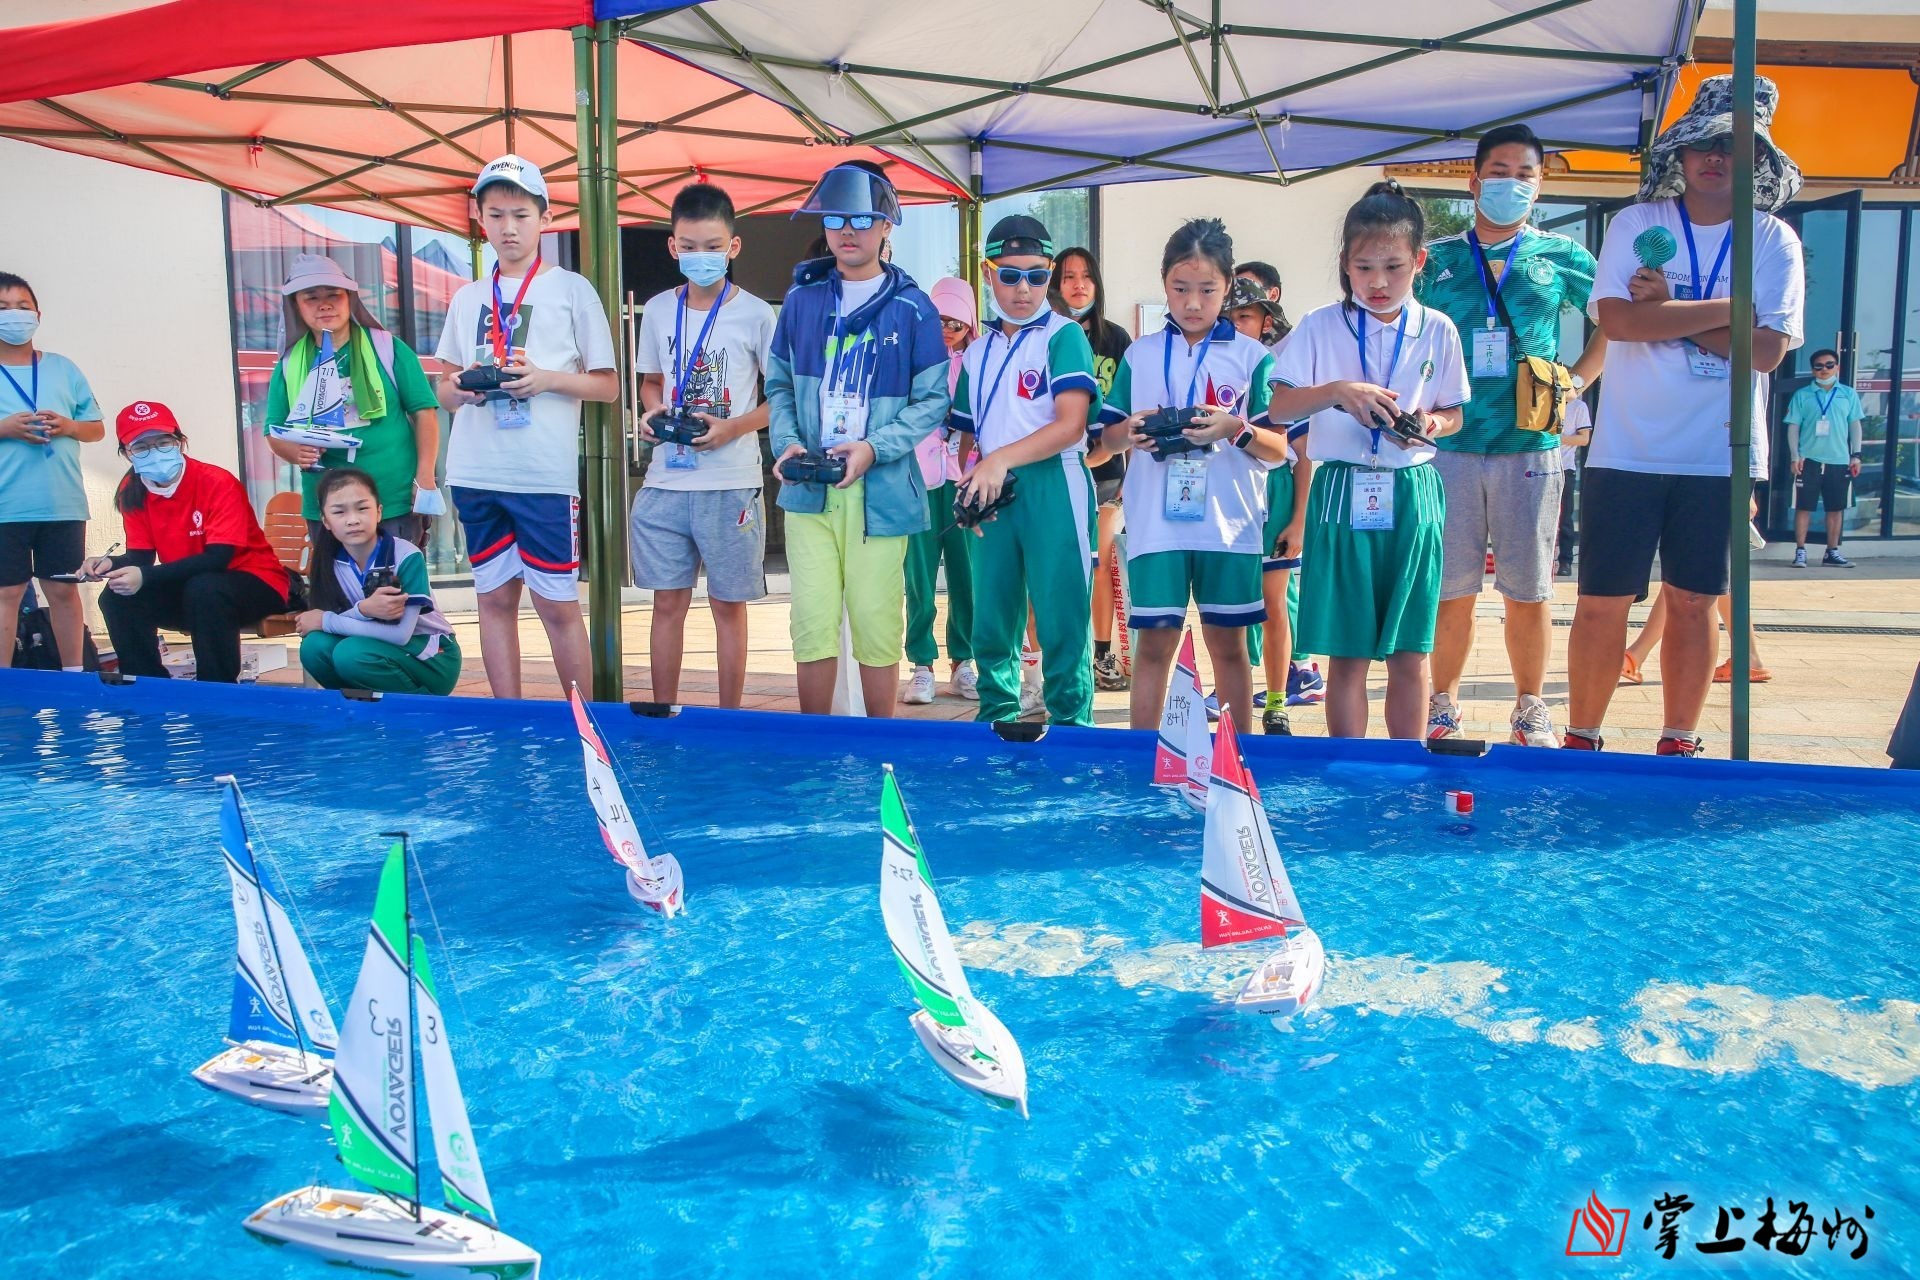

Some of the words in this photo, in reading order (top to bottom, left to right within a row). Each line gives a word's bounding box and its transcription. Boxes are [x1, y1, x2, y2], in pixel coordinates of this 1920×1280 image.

[490, 161, 525, 173] GIVENCHY
[1663, 270, 1690, 283] EEDOM
[316, 377, 327, 410] VOYAGER
